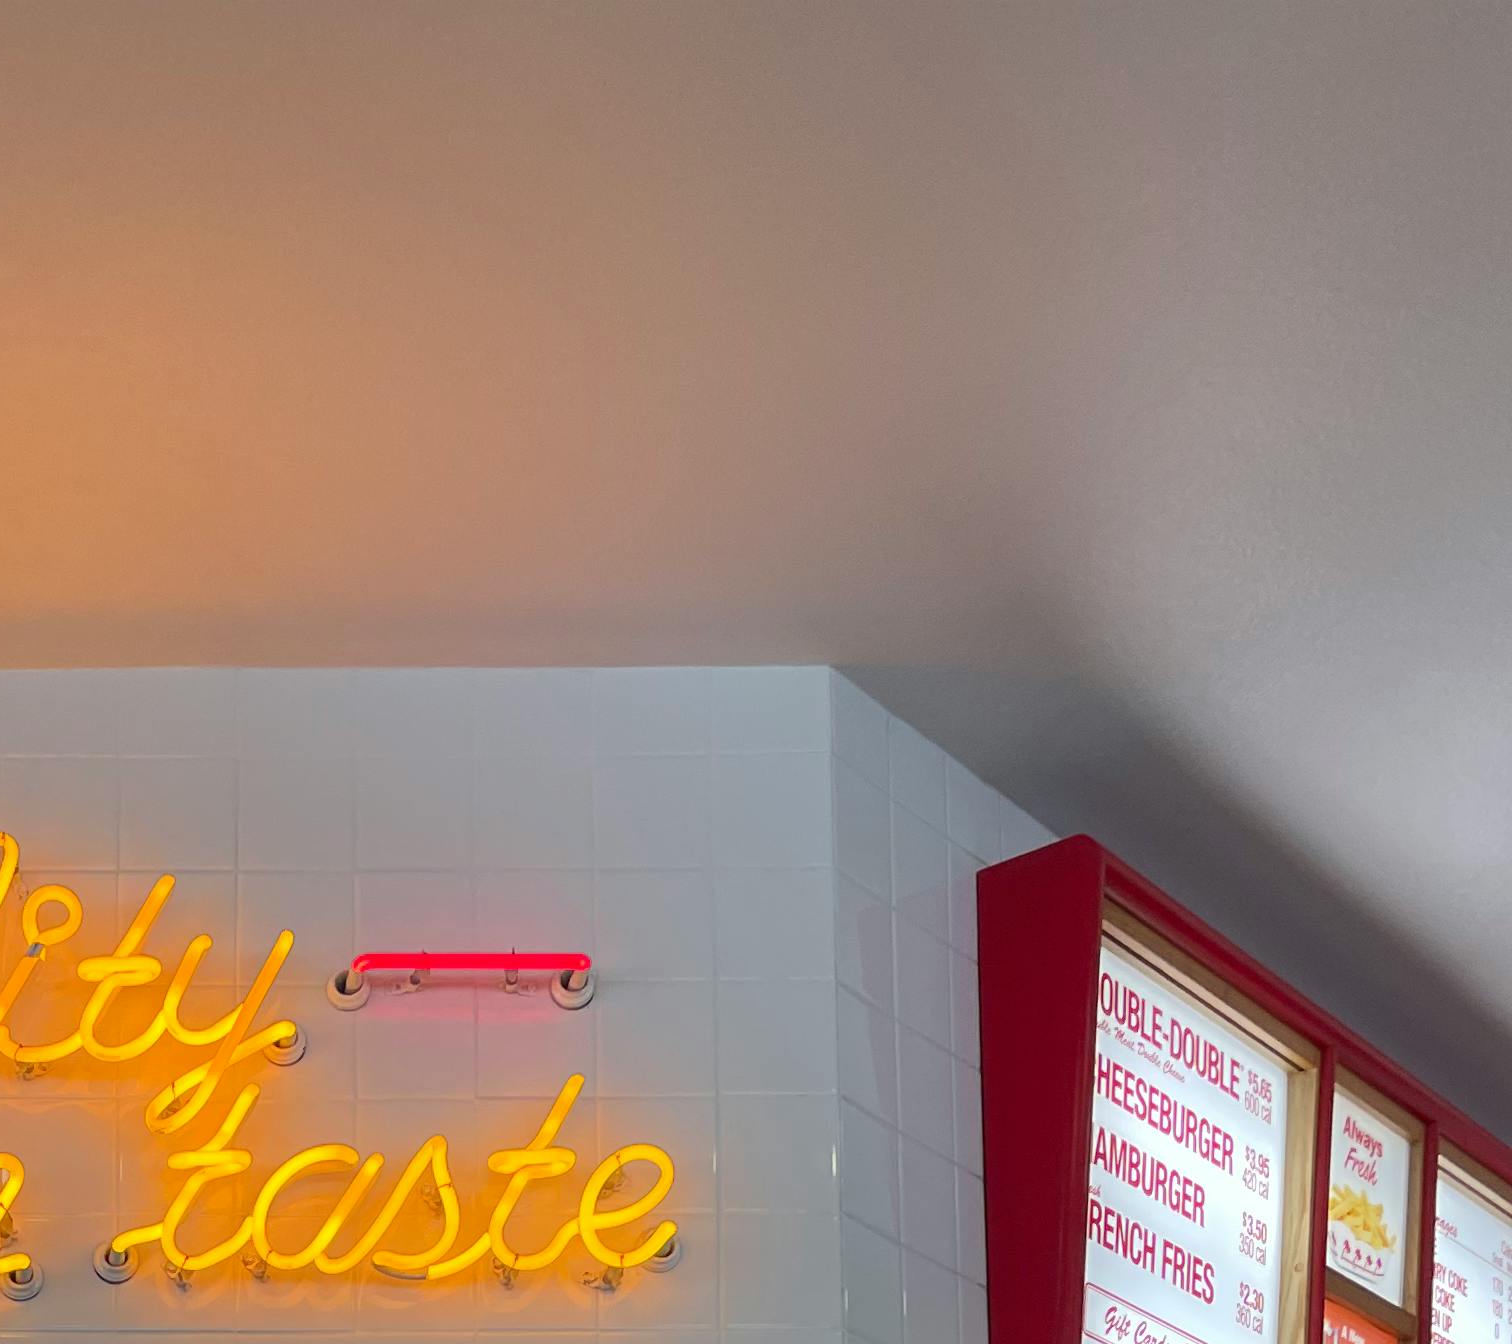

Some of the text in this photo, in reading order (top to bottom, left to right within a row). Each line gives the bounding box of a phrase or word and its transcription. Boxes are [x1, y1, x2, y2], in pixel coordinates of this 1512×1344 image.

[1100, 972, 1241, 1102] OUBLE-DOUBLE
[1097, 1053, 1270, 1179] HEESEBURGER $3.95
[1261, 1105, 1272, 1125] cal
[1343, 1115, 1383, 1158] Always
[111, 1075, 678, 1281] taste
[1093, 1126, 1268, 1244] AMBURGER $3.50
[1344, 1148, 1378, 1186] Fresh
[1258, 1180, 1270, 1200] cal
[1089, 1199, 1264, 1314] RENCH FRIES $2.30
[1256, 1247, 1267, 1265] cal
[1104, 1306, 1131, 1341] Gift
[1252, 1316, 1264, 1335] cal
